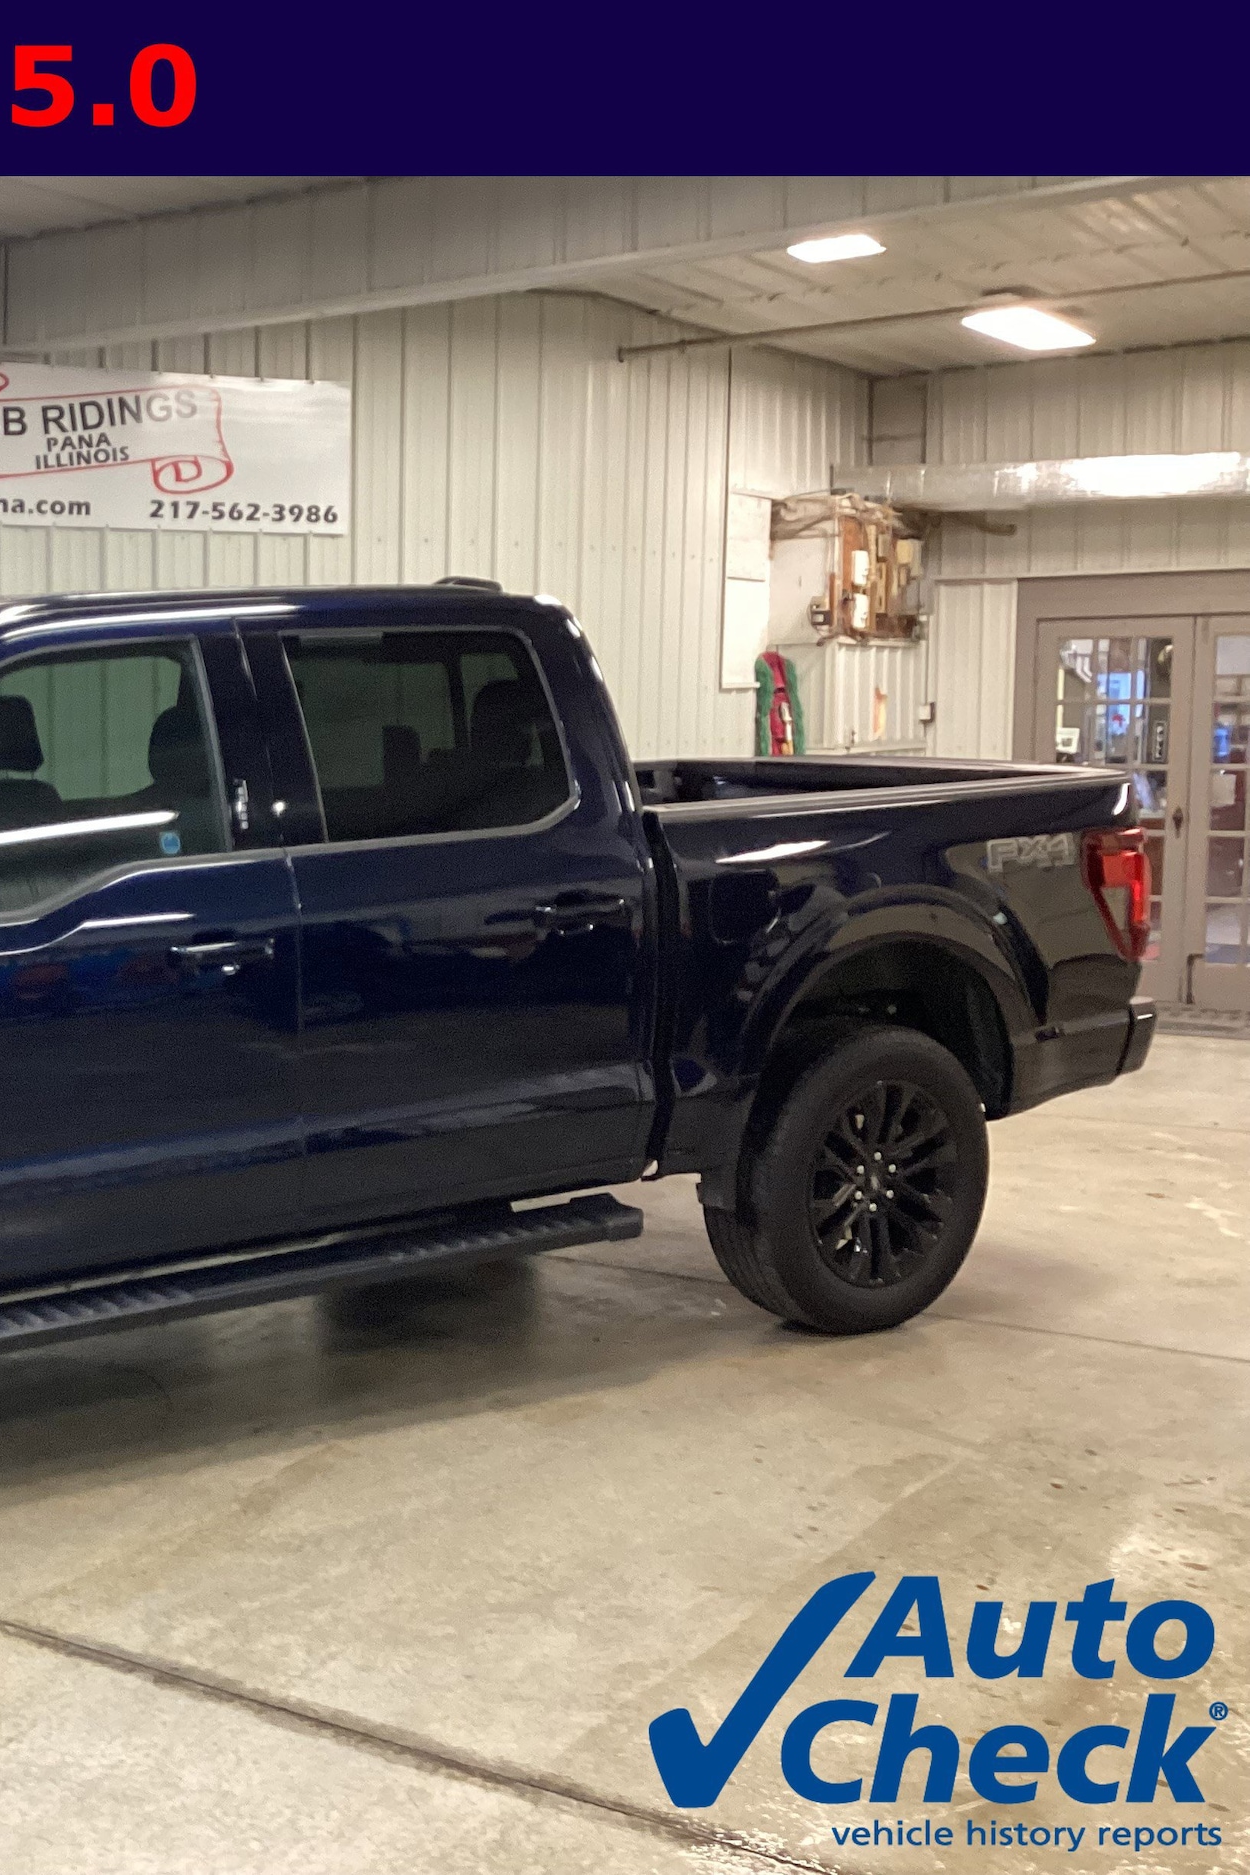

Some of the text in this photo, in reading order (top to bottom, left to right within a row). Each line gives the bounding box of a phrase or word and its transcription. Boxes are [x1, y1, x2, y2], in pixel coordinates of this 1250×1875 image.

[41, 389, 199, 436] RIDINGS
[46, 432, 113, 453] PANA
[35, 446, 130, 471] ILLINOIS
[149, 499, 338, 524] 217-562-3986
[986, 831, 1076, 874] FX4
